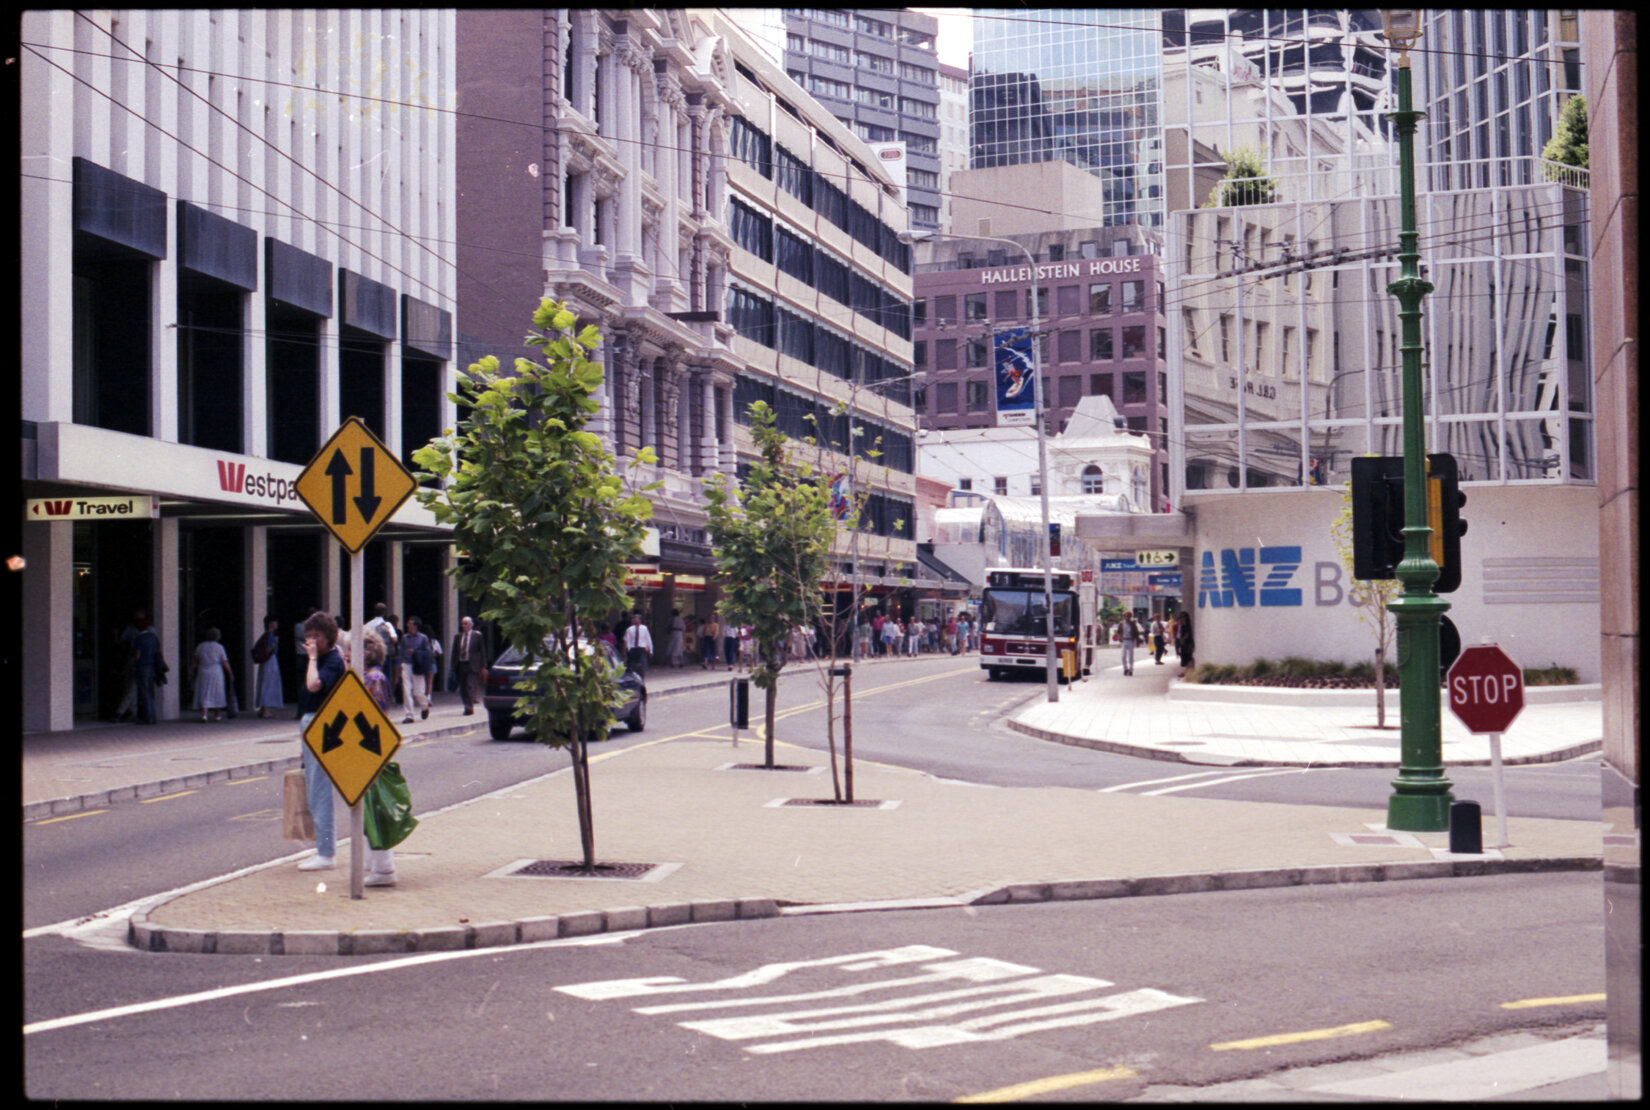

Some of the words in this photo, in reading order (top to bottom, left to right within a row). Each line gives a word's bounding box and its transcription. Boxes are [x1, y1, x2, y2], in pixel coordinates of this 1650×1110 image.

[1090, 258, 1141, 275] HOUSE
[217, 460, 297, 505] Westpa
[76, 500, 133, 515] Travel
[1199, 546, 1302, 608] ANZ
[1453, 674, 1518, 705] STOP
[552, 945, 1206, 1053] STOP
